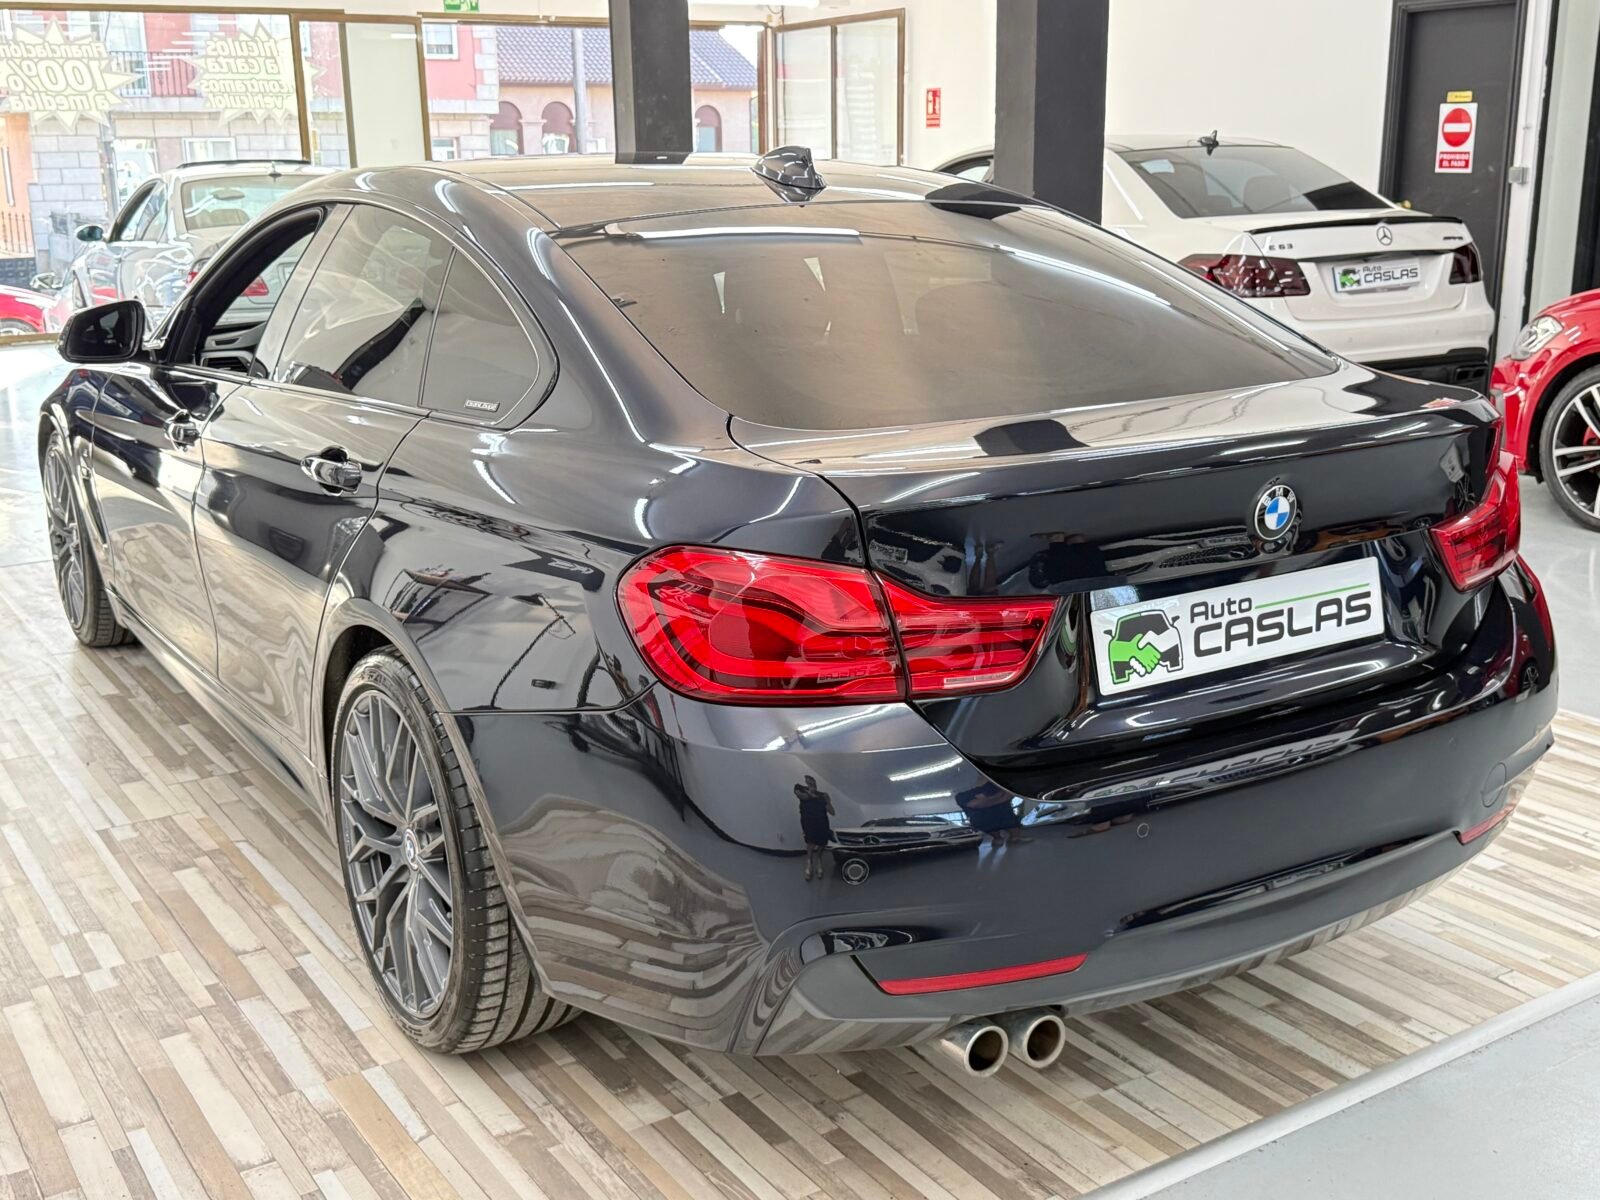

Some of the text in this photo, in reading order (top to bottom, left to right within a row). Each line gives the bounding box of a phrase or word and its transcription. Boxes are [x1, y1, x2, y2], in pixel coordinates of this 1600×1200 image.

[1364, 267, 1418, 283] CASLAS
[1262, 486, 1296, 507] BMW
[1190, 597, 1252, 623] Auto
[1194, 591, 1371, 657] CASLAS
